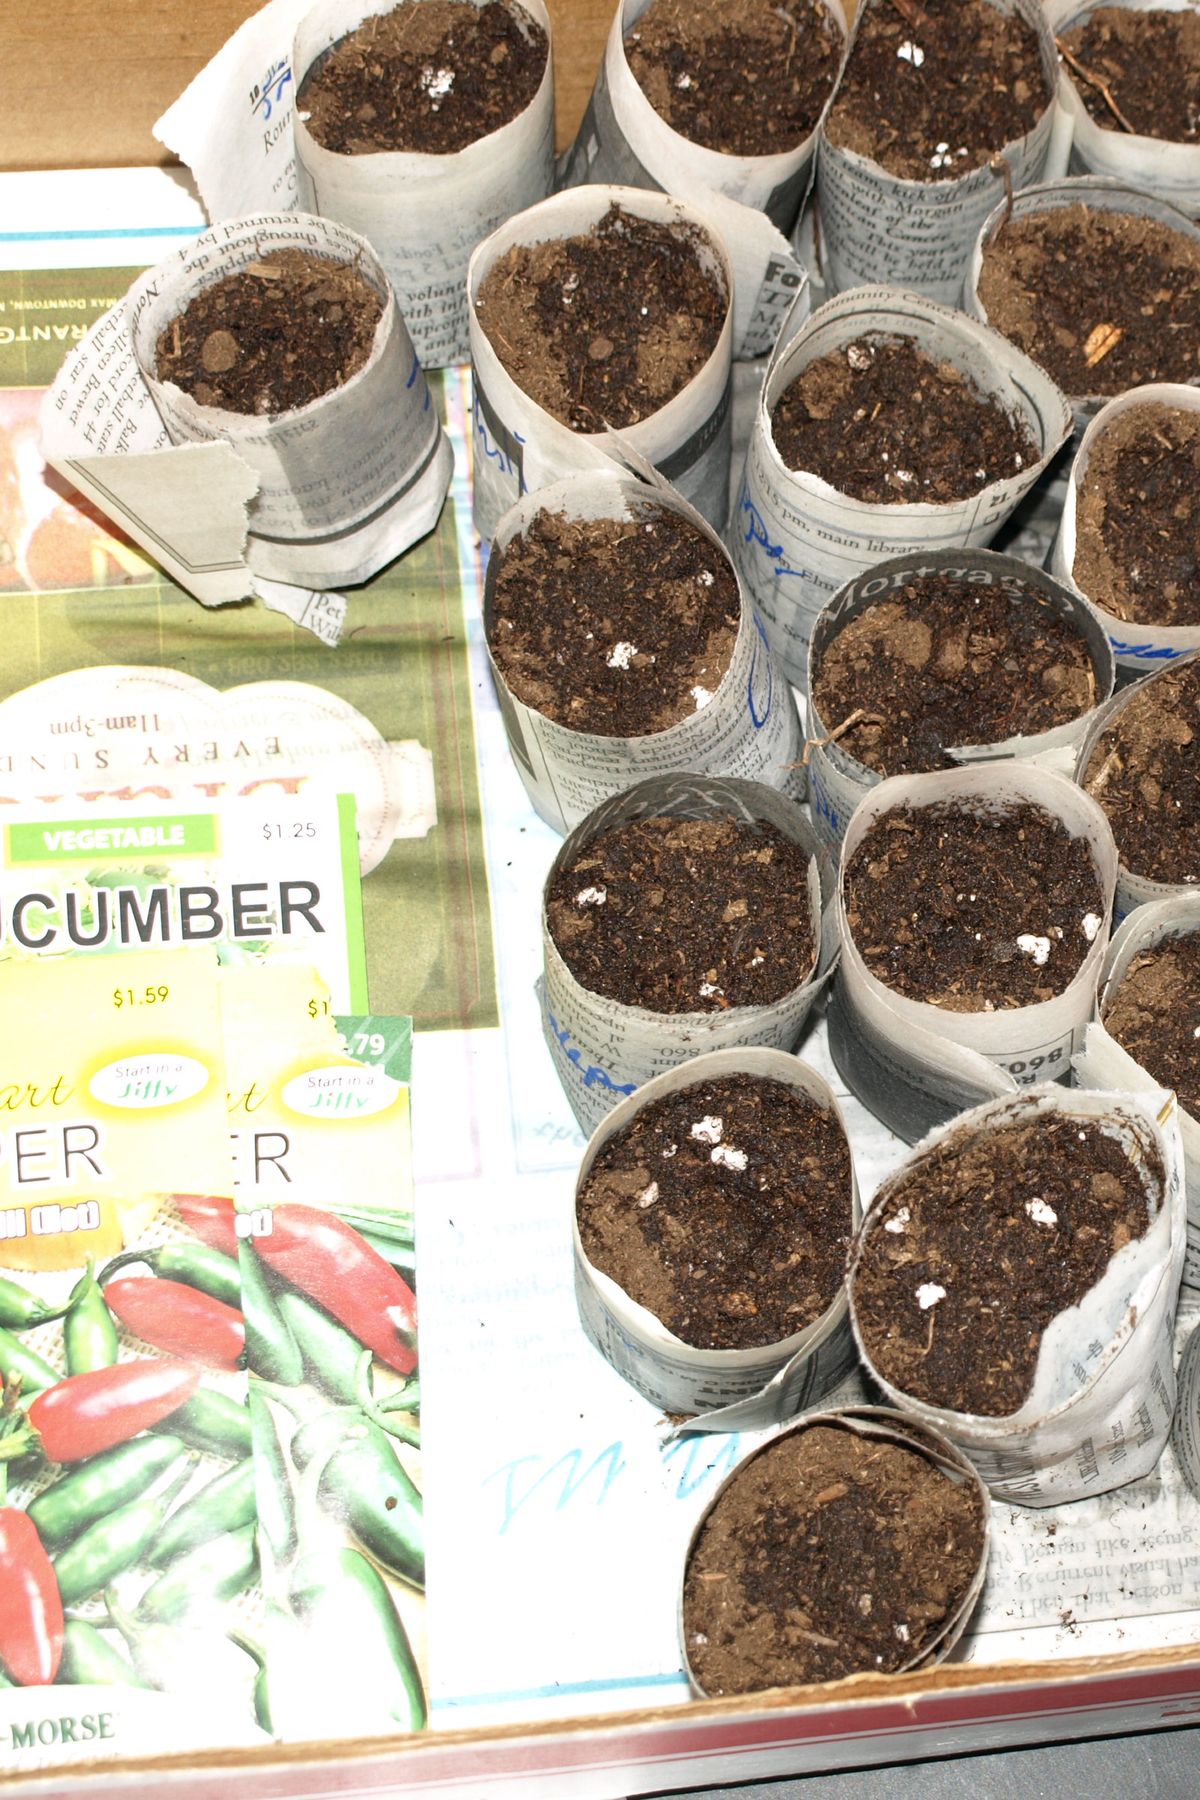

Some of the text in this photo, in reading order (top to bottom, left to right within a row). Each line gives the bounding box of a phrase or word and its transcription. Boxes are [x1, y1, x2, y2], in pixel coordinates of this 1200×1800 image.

[224, 216, 299, 234] returned
[219, 231, 318, 257] throughout
[69, 373, 101, 427] Brewer
[783, 508, 811, 532] pm,
[817, 528, 860, 549] main
[313, 591, 344, 620] Pet
[49, 713, 160, 736] 11am-3pm
[142, 735, 281, 766] EVERY
[43, 824, 186, 851] VEGETABLE
[262, 821, 317, 841] $1.25
[12, 880, 326, 949] CUMBER
[113, 986, 170, 1009] $1.59
[115, 1064, 150, 1079] Start
[308, 1075, 343, 1089] Start
